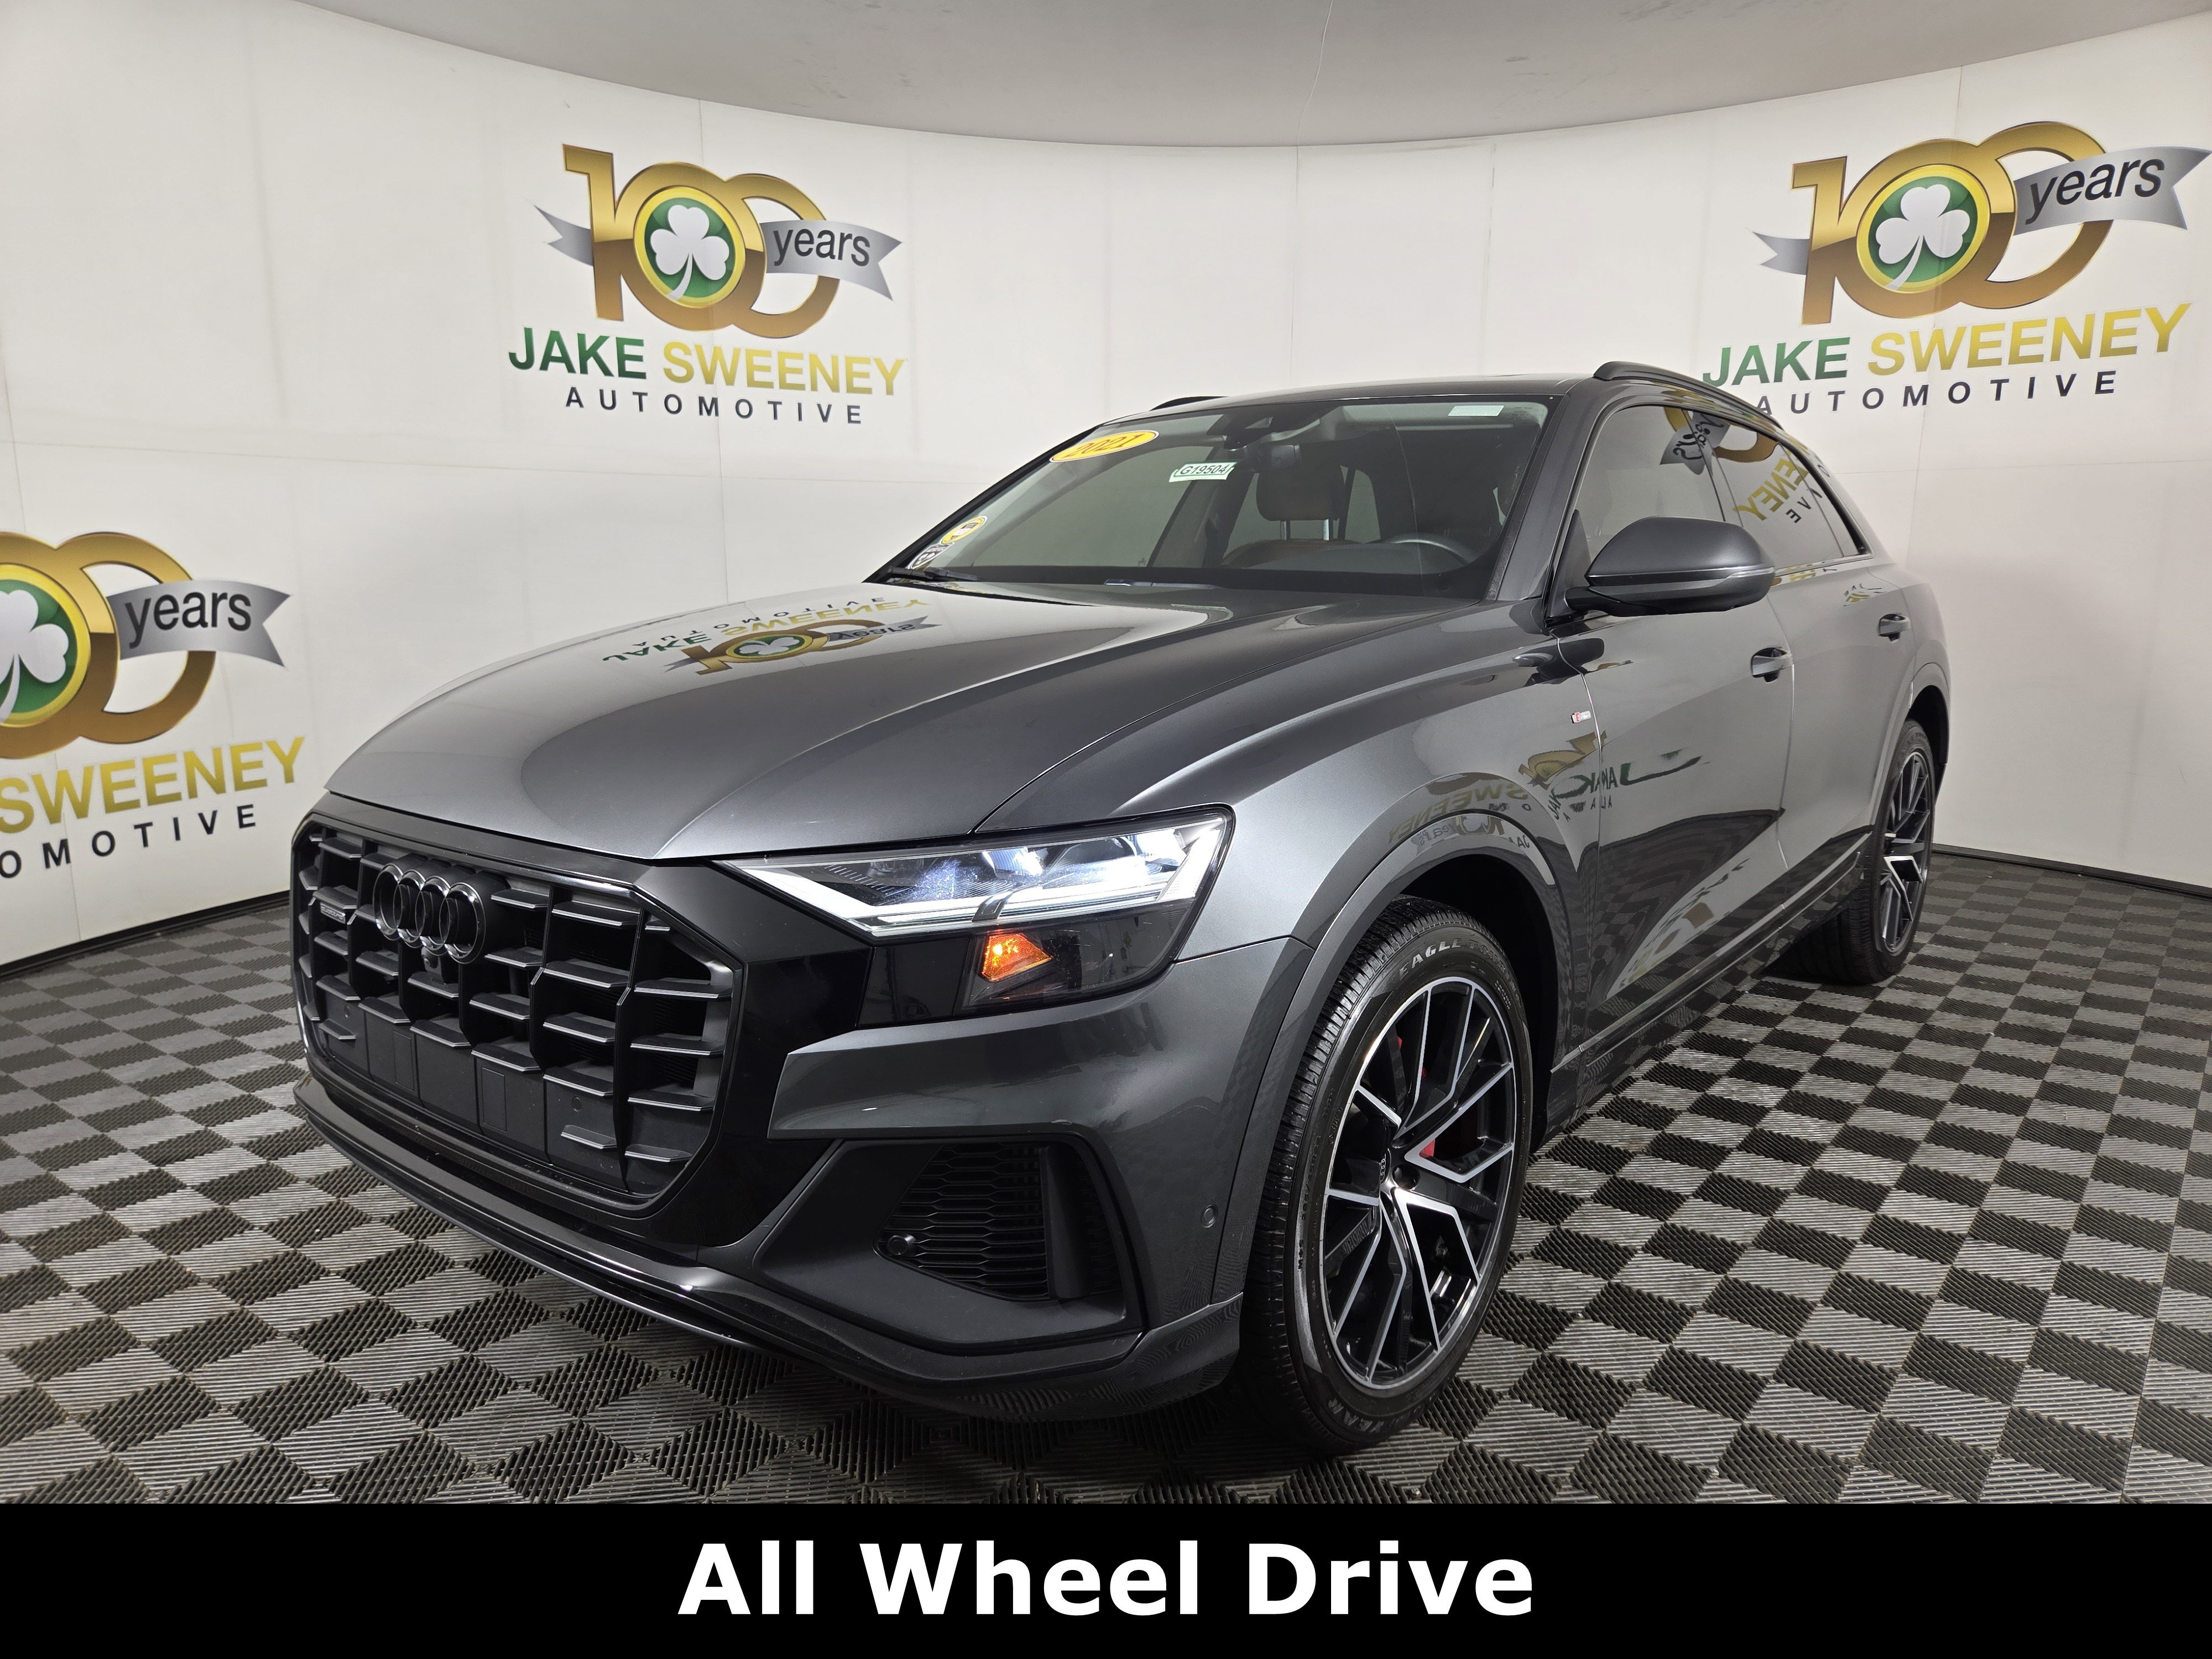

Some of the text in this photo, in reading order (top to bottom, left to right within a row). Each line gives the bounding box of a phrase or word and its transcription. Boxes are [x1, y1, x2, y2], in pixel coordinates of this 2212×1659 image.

[2026, 158, 2164, 225] years
[772, 227, 870, 267] years
[508, 327, 905, 395] JAKE SWEENEY
[1703, 302, 2192, 387] JAKE SWEENEY
[565, 387, 862, 424] AUTOMOTIVE
[1757, 371, 2117, 415] AUTOMOTIVE
[1061, 433, 1146, 459] 2021
[1180, 463, 1229, 474] G19504
[124, 592, 252, 649] years
[0, 736, 305, 833] SWEENEY
[0, 804, 256, 878] OMOTIVE
[1399, 938, 1462, 980] EAGLE
